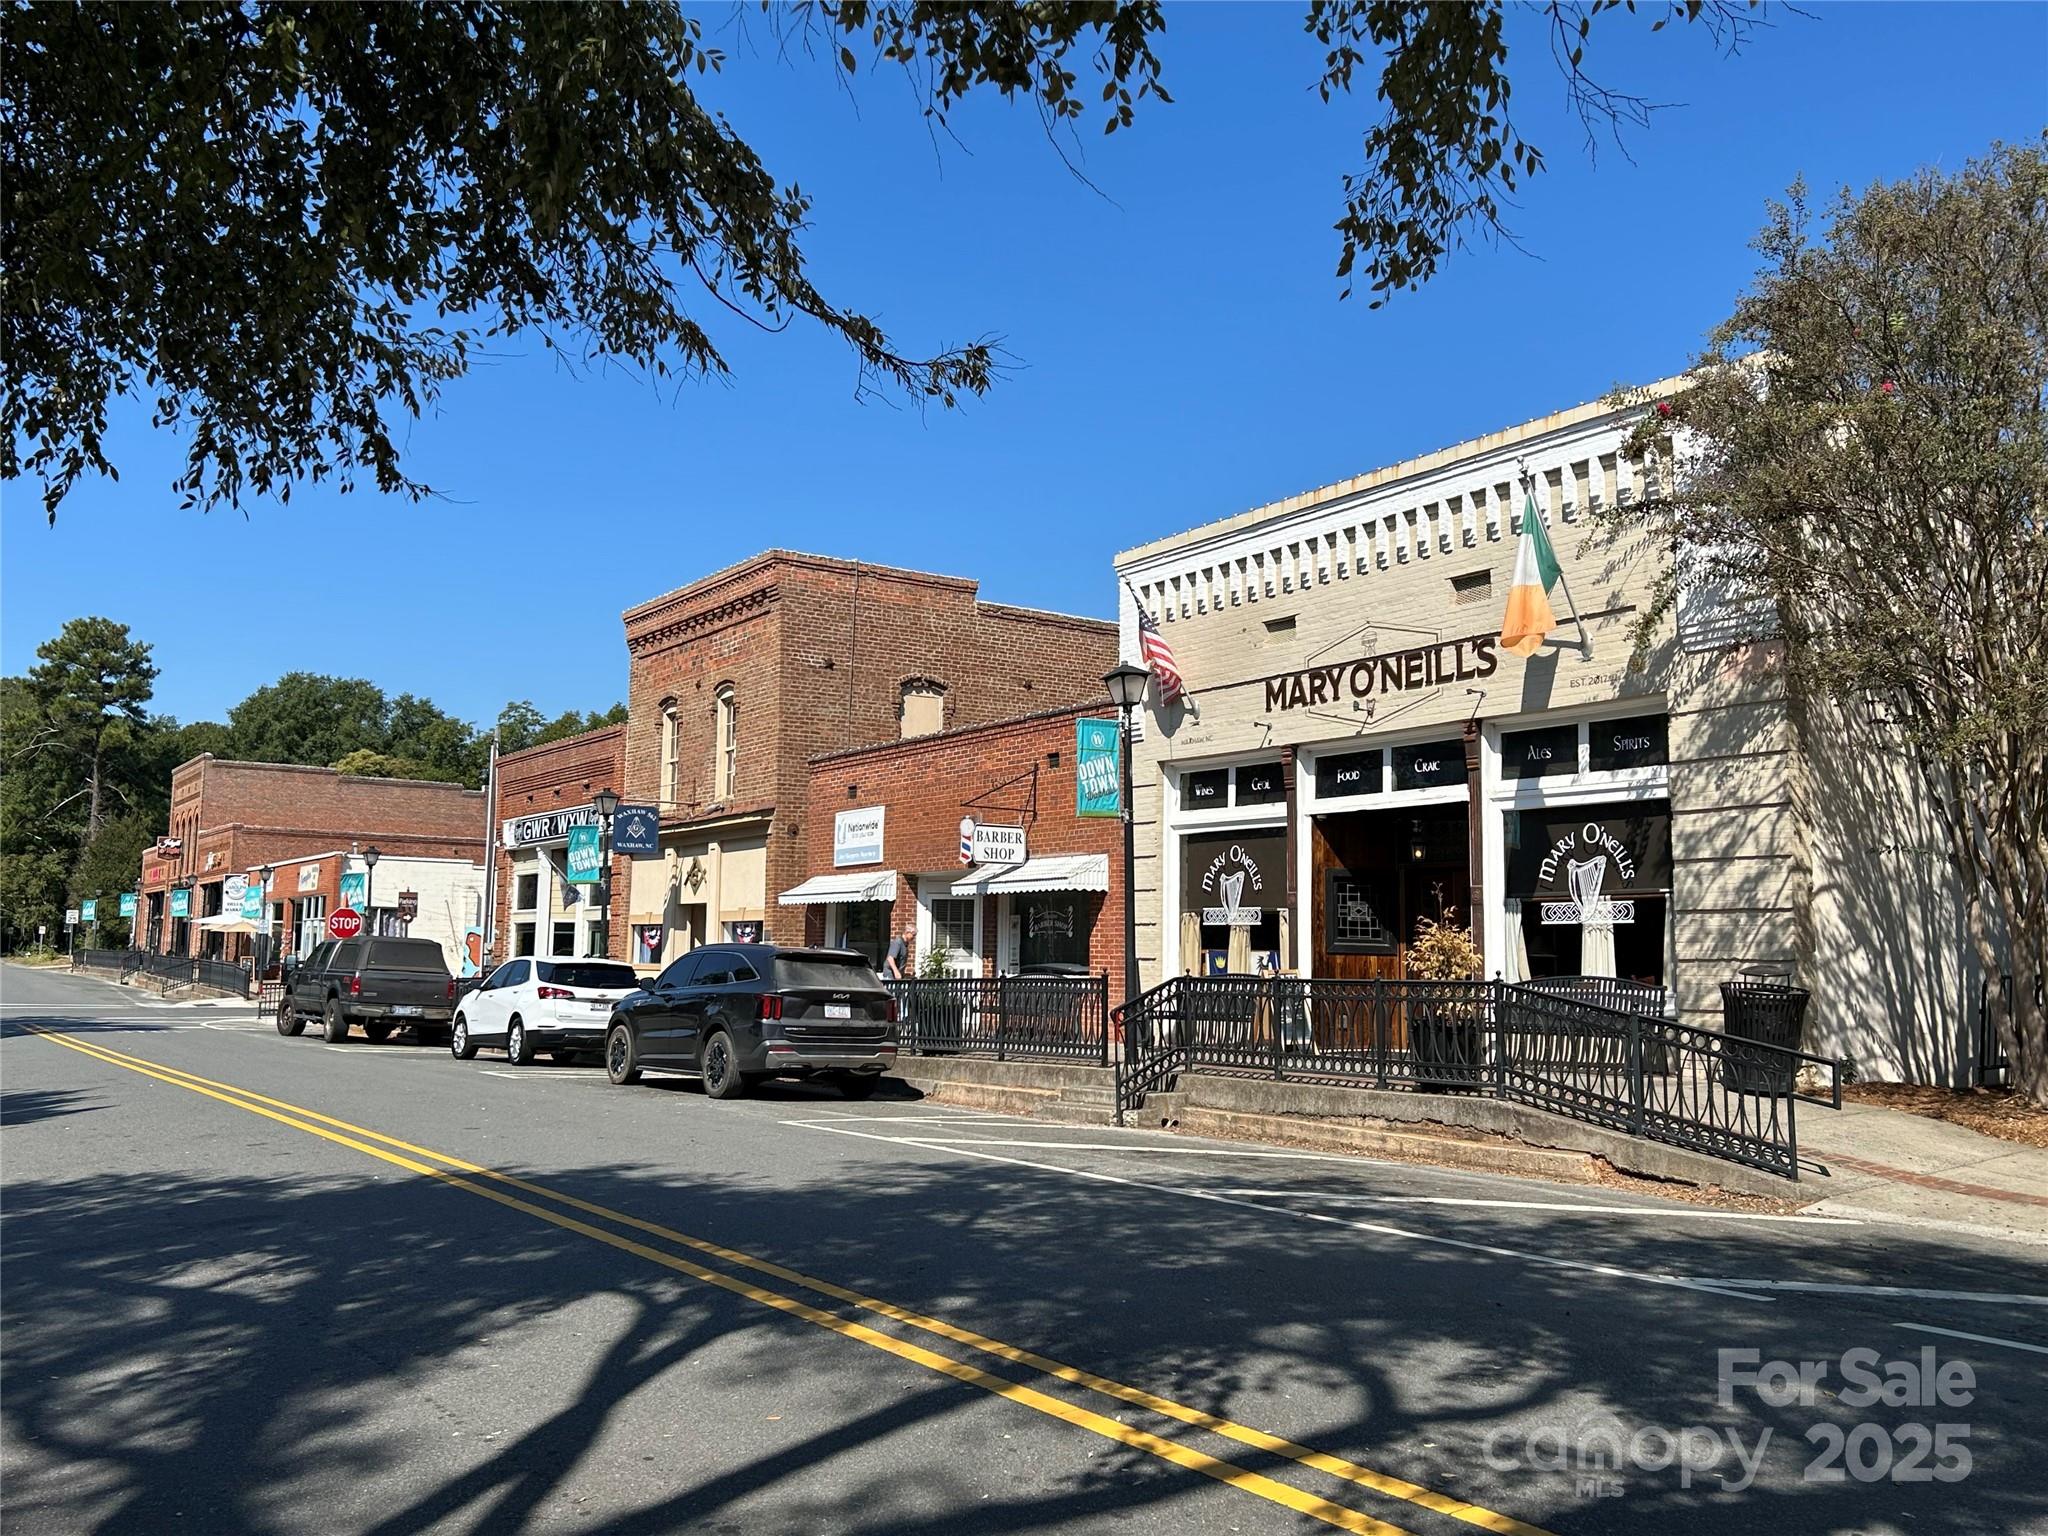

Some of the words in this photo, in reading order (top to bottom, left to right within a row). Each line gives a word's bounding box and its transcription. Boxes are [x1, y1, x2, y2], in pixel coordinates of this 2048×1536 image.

[1265, 667, 1346, 713] MARY
[1350, 636, 1497, 698] O'NEILL'S
[1613, 735, 1651, 752] SPIRITS
[1527, 745, 1552, 760] ALES
[1079, 755, 1115, 781] DOWN
[1414, 758, 1441, 773] CRAIC
[1082, 772, 1118, 794] TOWN
[1337, 768, 1360, 783] FOOD
[616, 808, 646, 819] WAXHAW
[523, 818, 549, 839] GWR
[848, 820, 879, 833] Nationwide
[976, 830, 1022, 844] BARBER
[568, 846, 596, 862] DOWN
[983, 847, 1015, 860] SHOP
[1539, 831, 1575, 883] MARY
[1582, 822, 1635, 880] O'NEILL'S
[571, 856, 599, 871] TOWN
[1201, 851, 1226, 892] MARY
[1229, 844, 1263, 891] O'NEILL'S
[399, 897, 417, 906] Parking
[331, 917, 360, 929] STOP
